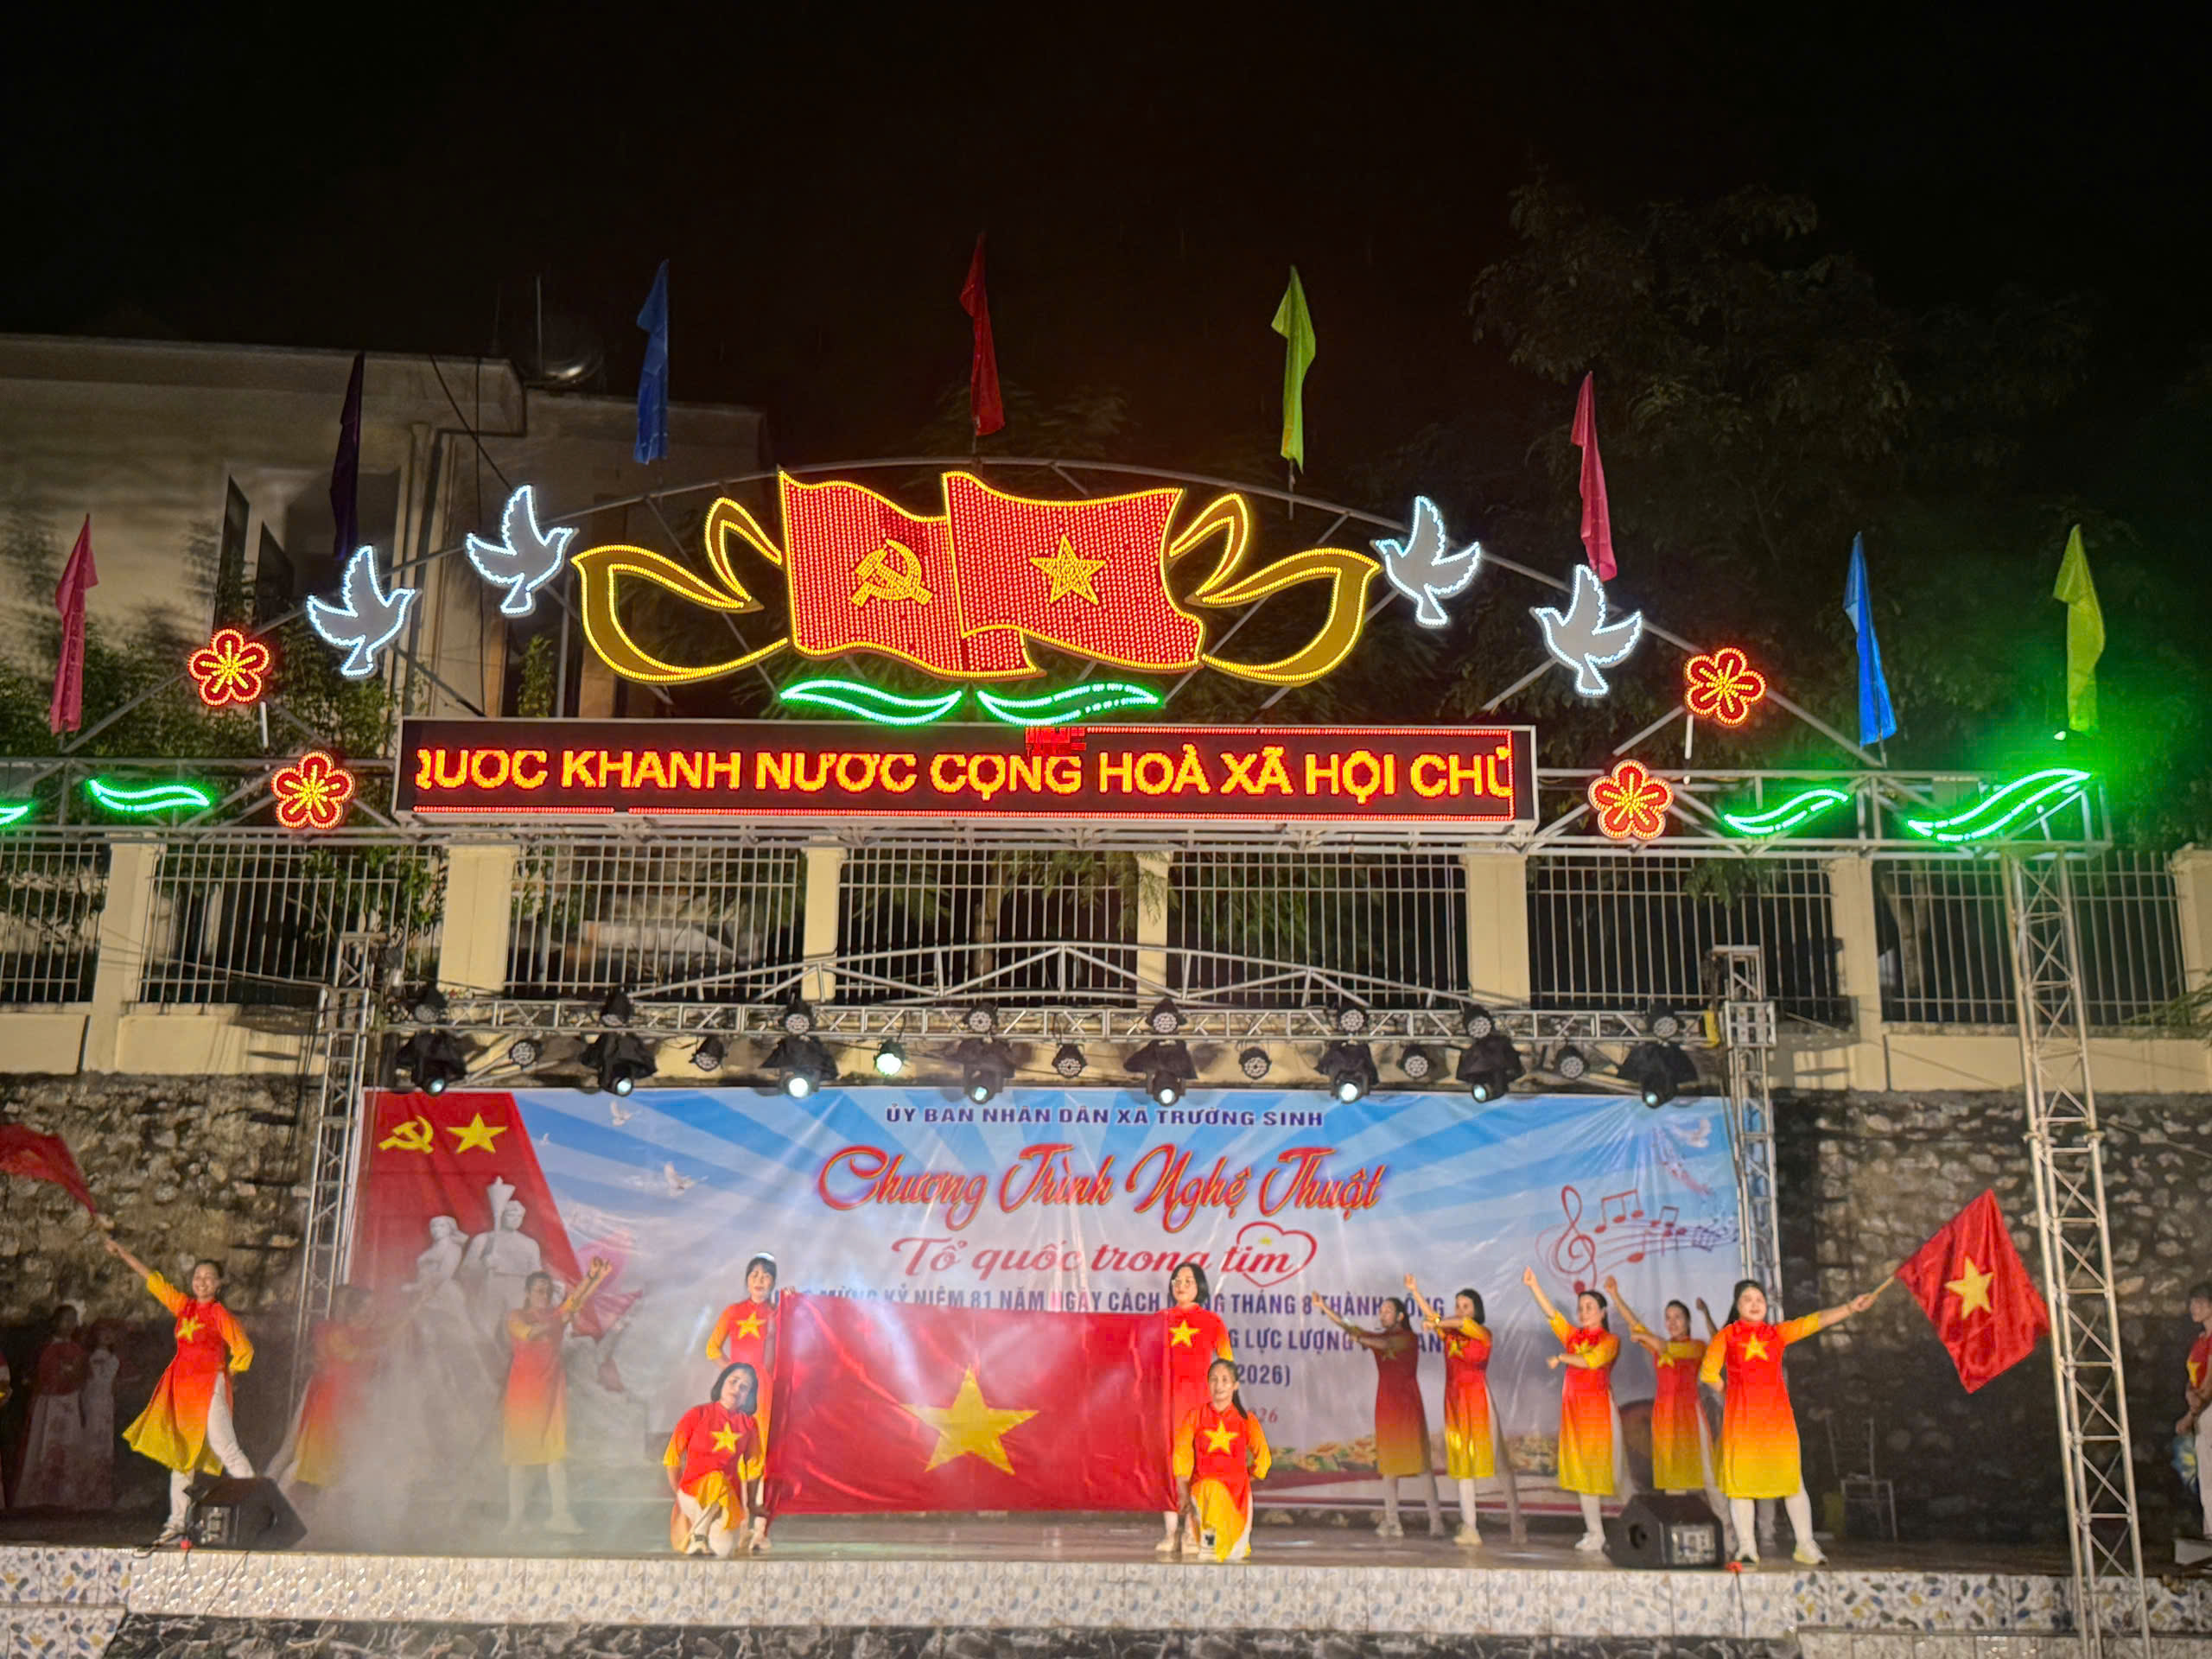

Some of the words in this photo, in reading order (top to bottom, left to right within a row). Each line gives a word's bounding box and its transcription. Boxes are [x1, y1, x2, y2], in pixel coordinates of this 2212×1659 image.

[562, 750, 741, 789] KHANH
[1220, 746, 1294, 795] XÃ
[887, 1103, 915, 1122] ỦY
[925, 1108, 974, 1122] BAN
[982, 1105, 1051, 1123] NHÂN
[1058, 1105, 1109, 1123] DÂN
[1117, 1107, 1148, 1124] XÃ
[1157, 1107, 1255, 1125] TRƯỜNG
[1263, 1111, 1323, 1127] SINH
[819, 1145, 988, 1230] Chương
[999, 1143, 1116, 1213] Trình
[1125, 1143, 1252, 1233] Nghệ
[1259, 1147, 1387, 1221] Thuật
[891, 1236, 968, 1276] Tổ
[971, 1240, 1082, 1281] quốc
[1221, 1245, 1297, 1273] tim
[970, 1290, 992, 1308] 81
[1000, 1287, 1045, 1311] NĂM
[1108, 1287, 1160, 1312] CÁCH
[1230, 1289, 1295, 1315] THÁNG
[1301, 1295, 1313, 1315] 8
[1245, 1327, 1282, 1354] LỰC
[1287, 1327, 1353, 1355] LƯỢNG
